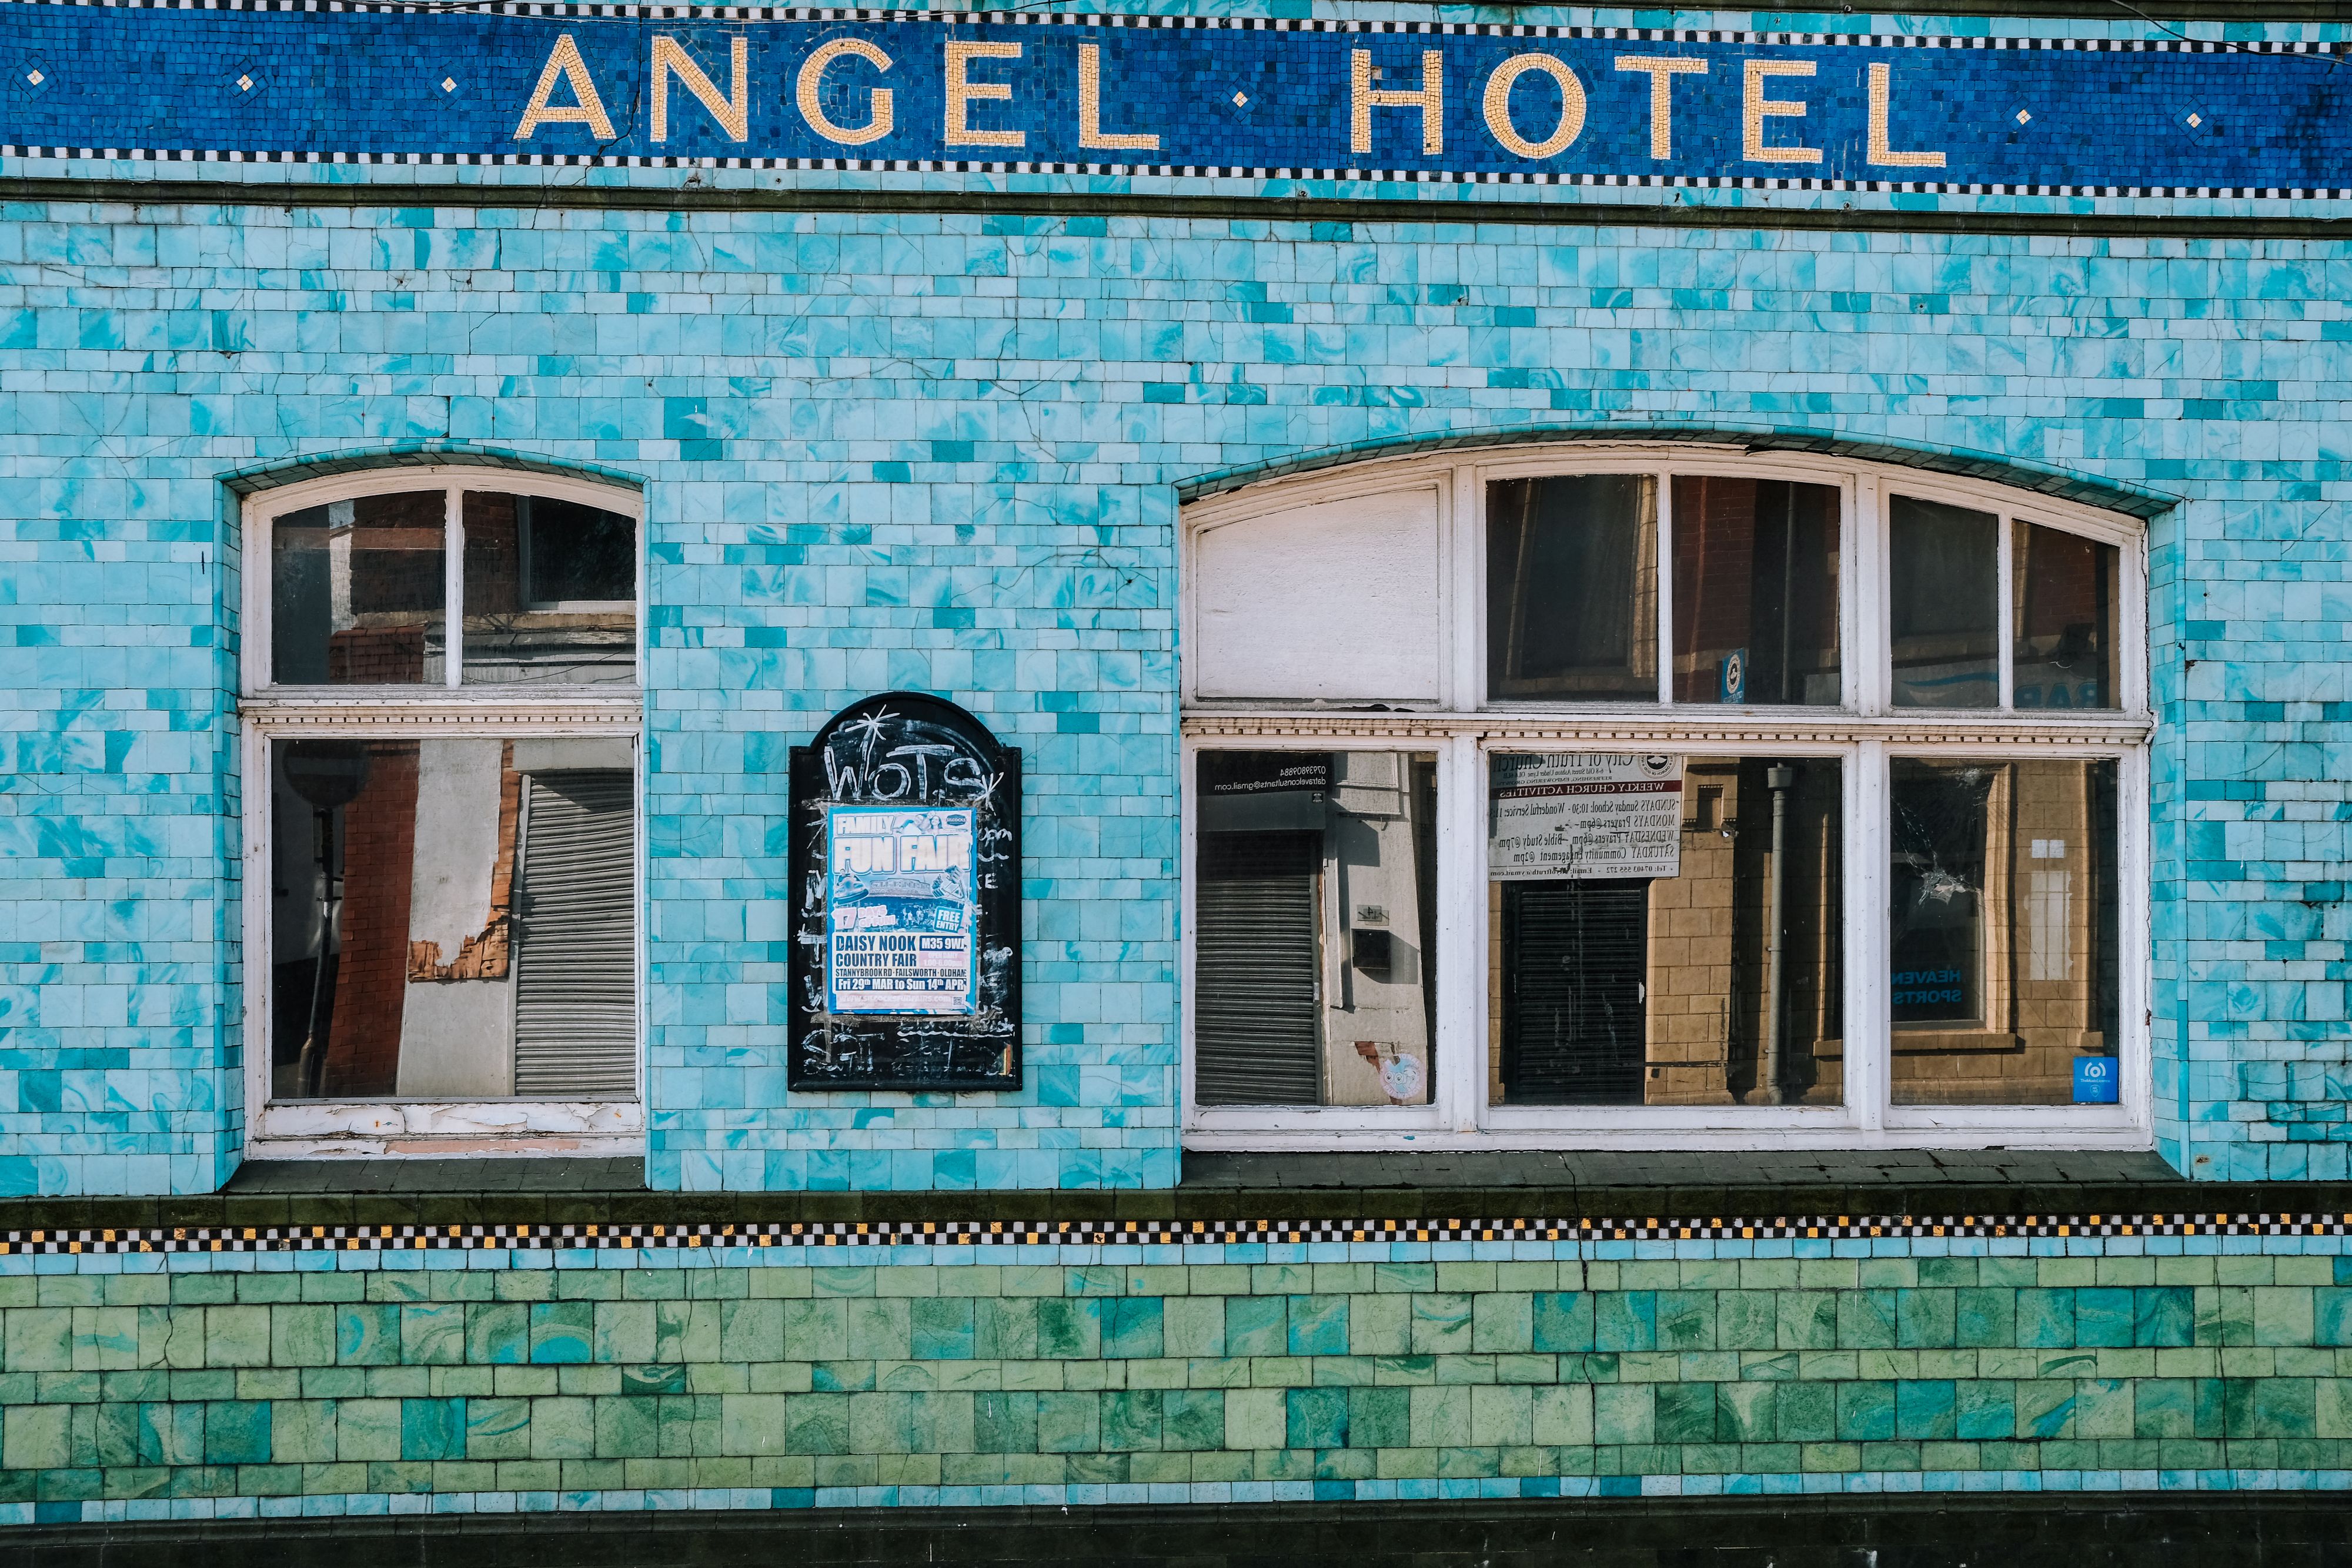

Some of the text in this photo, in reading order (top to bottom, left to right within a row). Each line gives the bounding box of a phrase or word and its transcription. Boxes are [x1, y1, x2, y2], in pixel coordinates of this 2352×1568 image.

[512, 34, 1946, 168] ANGEL HOTEL
[837, 815, 894, 835] FAMILY
[834, 835, 971, 874] FUN FAIR
[858, 905, 887, 918] DAYS
[938, 911, 960, 922] FREE
[833, 908, 857, 930] 17
[859, 917, 874, 928] OF
[936, 921, 959, 931] ENTRY
[836, 935, 916, 951] DAISY NOOK
[921, 938, 944, 950] M35
[836, 954, 917, 967] COUNTRY FAIR
[838, 979, 851, 989] Fri
[852, 979, 870, 989] 29th
[873, 979, 893, 989] MAR
[895, 979, 905, 989] to
[907, 979, 925, 989] Sun
[928, 979, 944, 989] 14th
